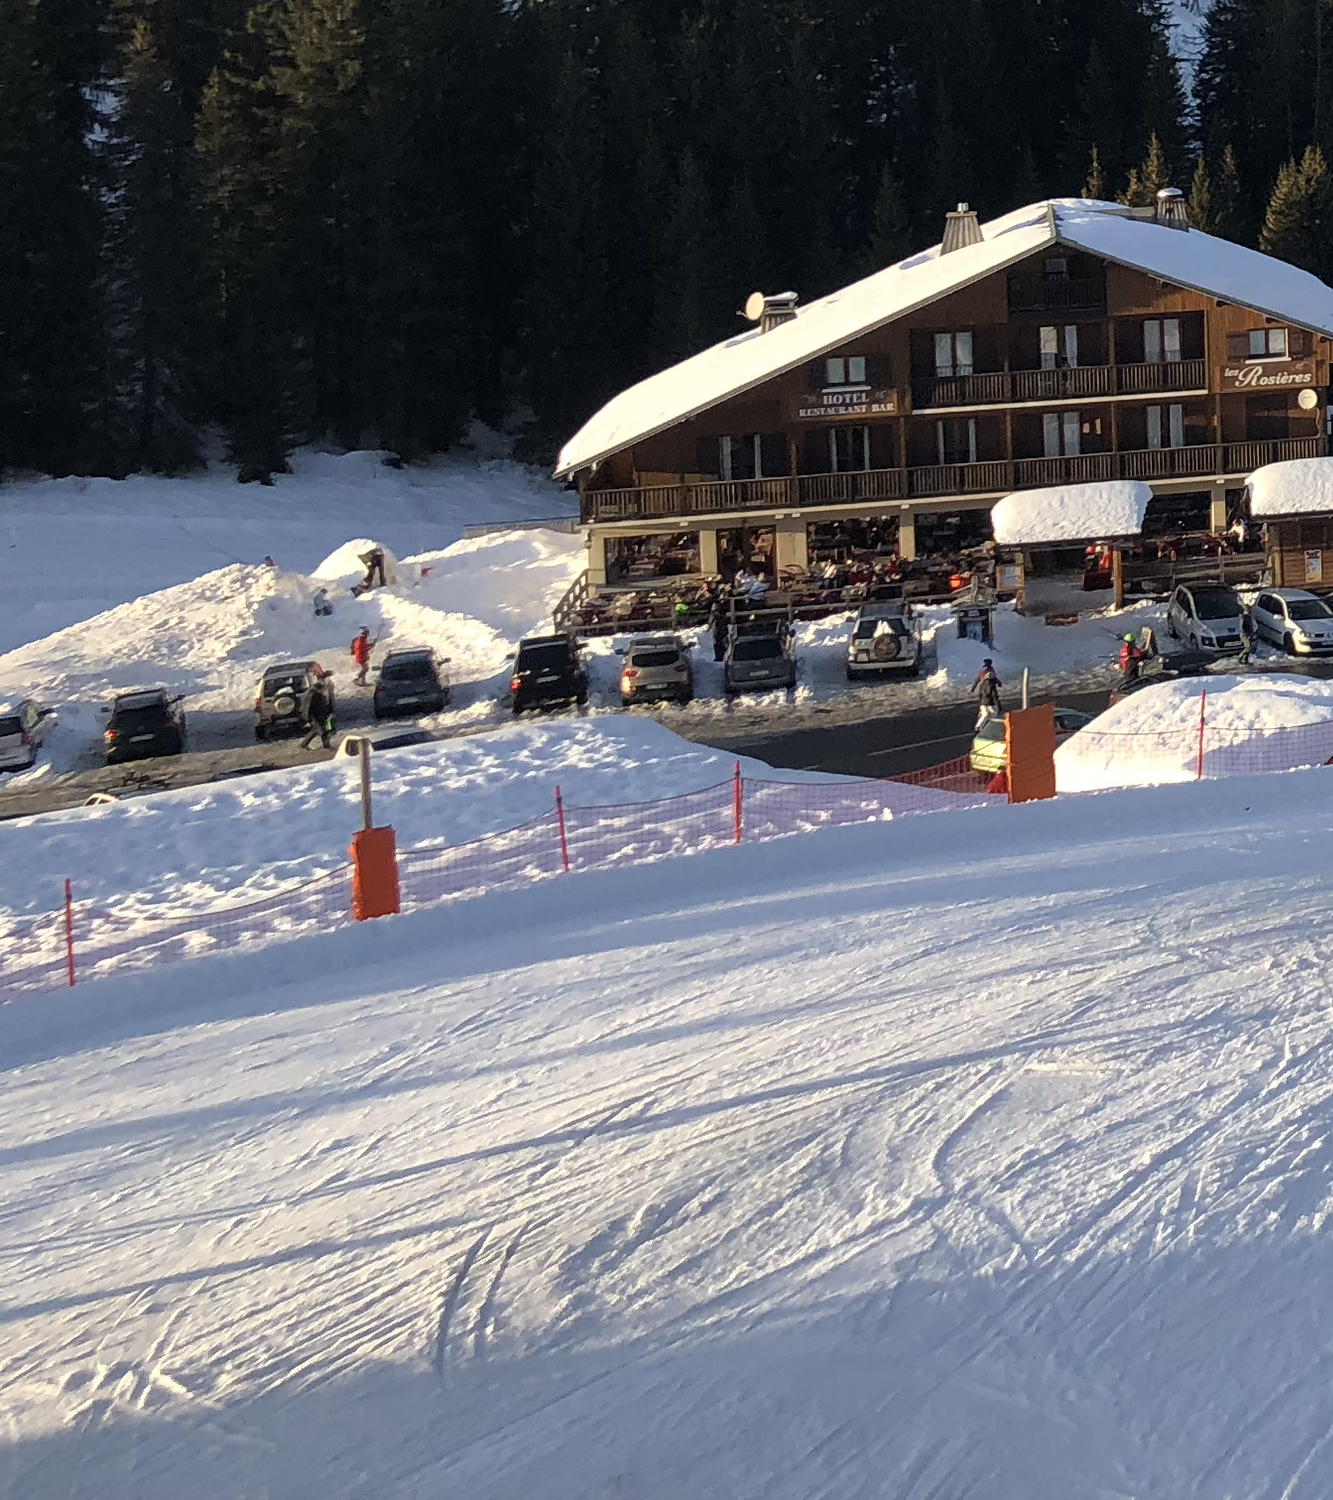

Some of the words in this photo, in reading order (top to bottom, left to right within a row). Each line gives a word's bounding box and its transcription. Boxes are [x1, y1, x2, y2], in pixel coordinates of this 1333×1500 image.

[1224, 367, 1239, 377] les
[1235, 365, 1312, 387] Rosières
[823, 393, 870, 405] HOTEL
[800, 405, 867, 417] RESTAURANT
[872, 403, 895, 413] BAR
